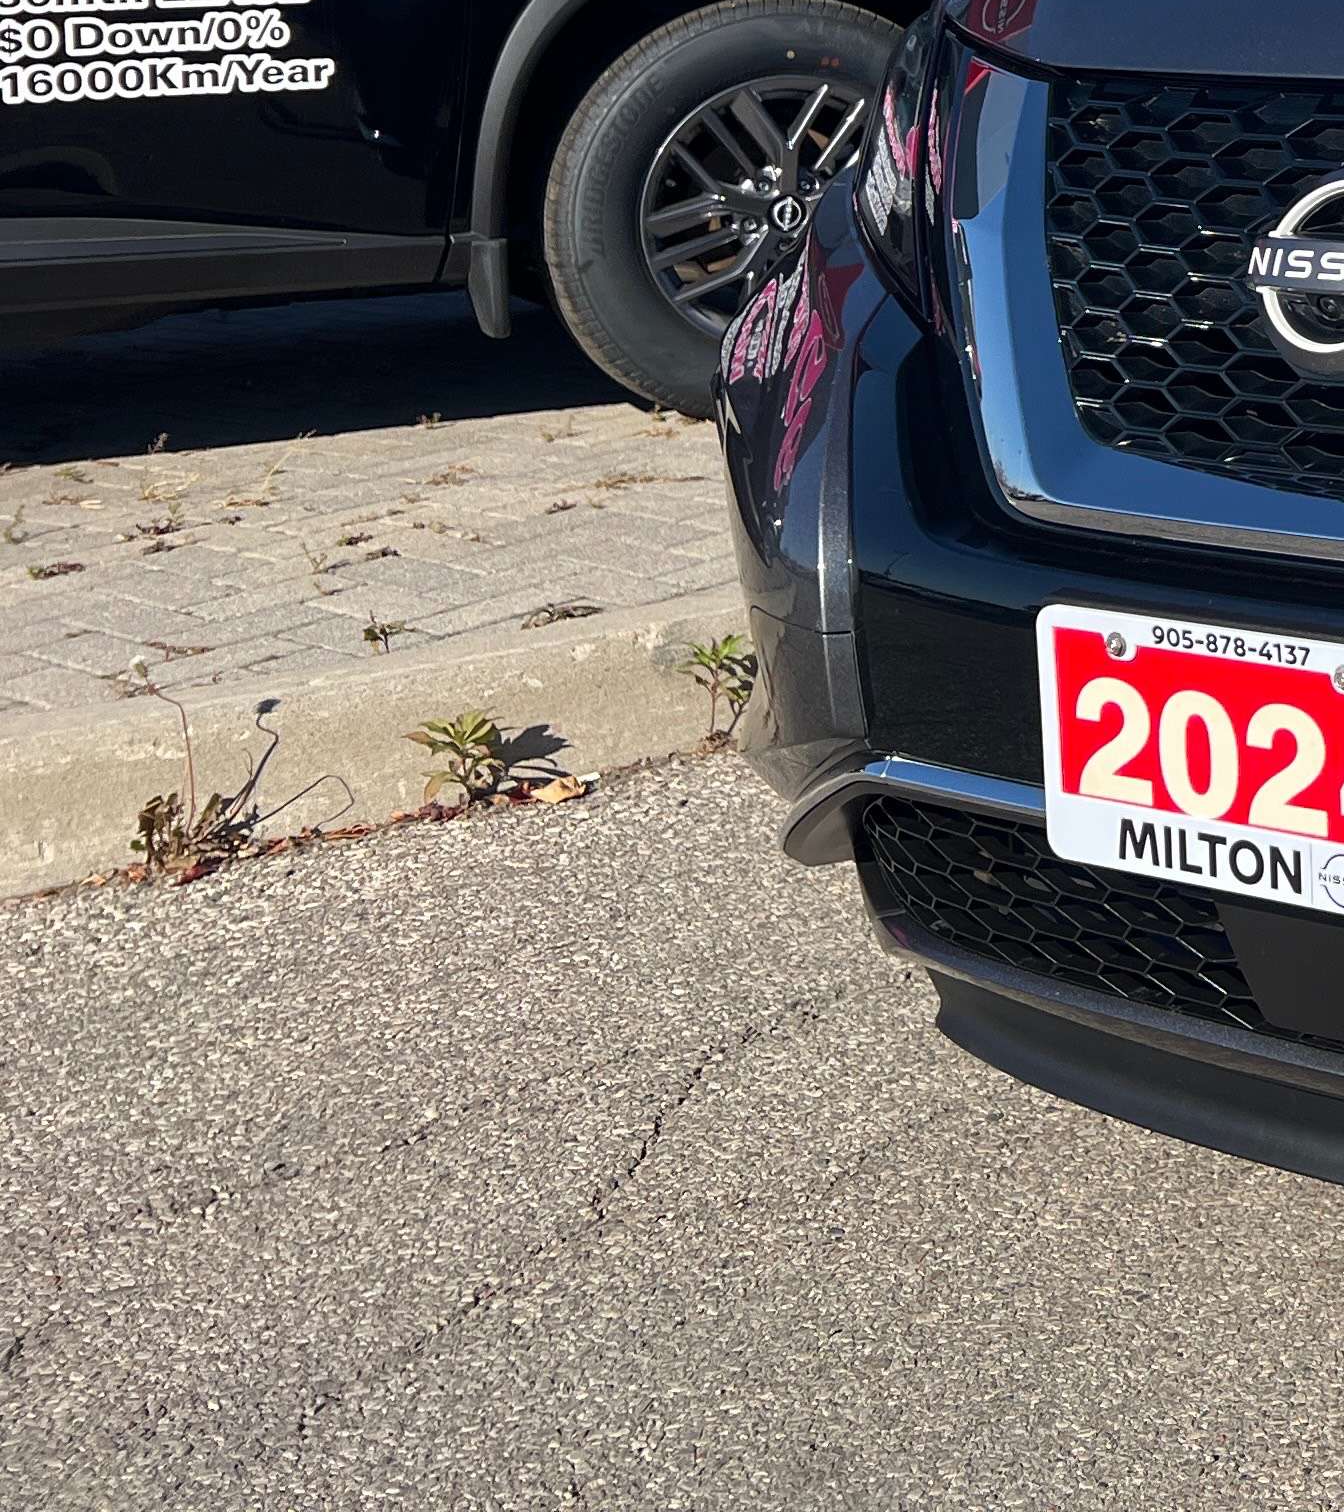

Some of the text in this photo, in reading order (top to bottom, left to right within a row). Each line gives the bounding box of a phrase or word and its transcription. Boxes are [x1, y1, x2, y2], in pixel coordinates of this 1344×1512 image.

[70, 12, 288, 54] Down/0%
[0, 56, 332, 101] 16000Km/Year
[1151, 625, 1311, 667] 905-878-4137
[1118, 818, 1303, 895] MILTON
